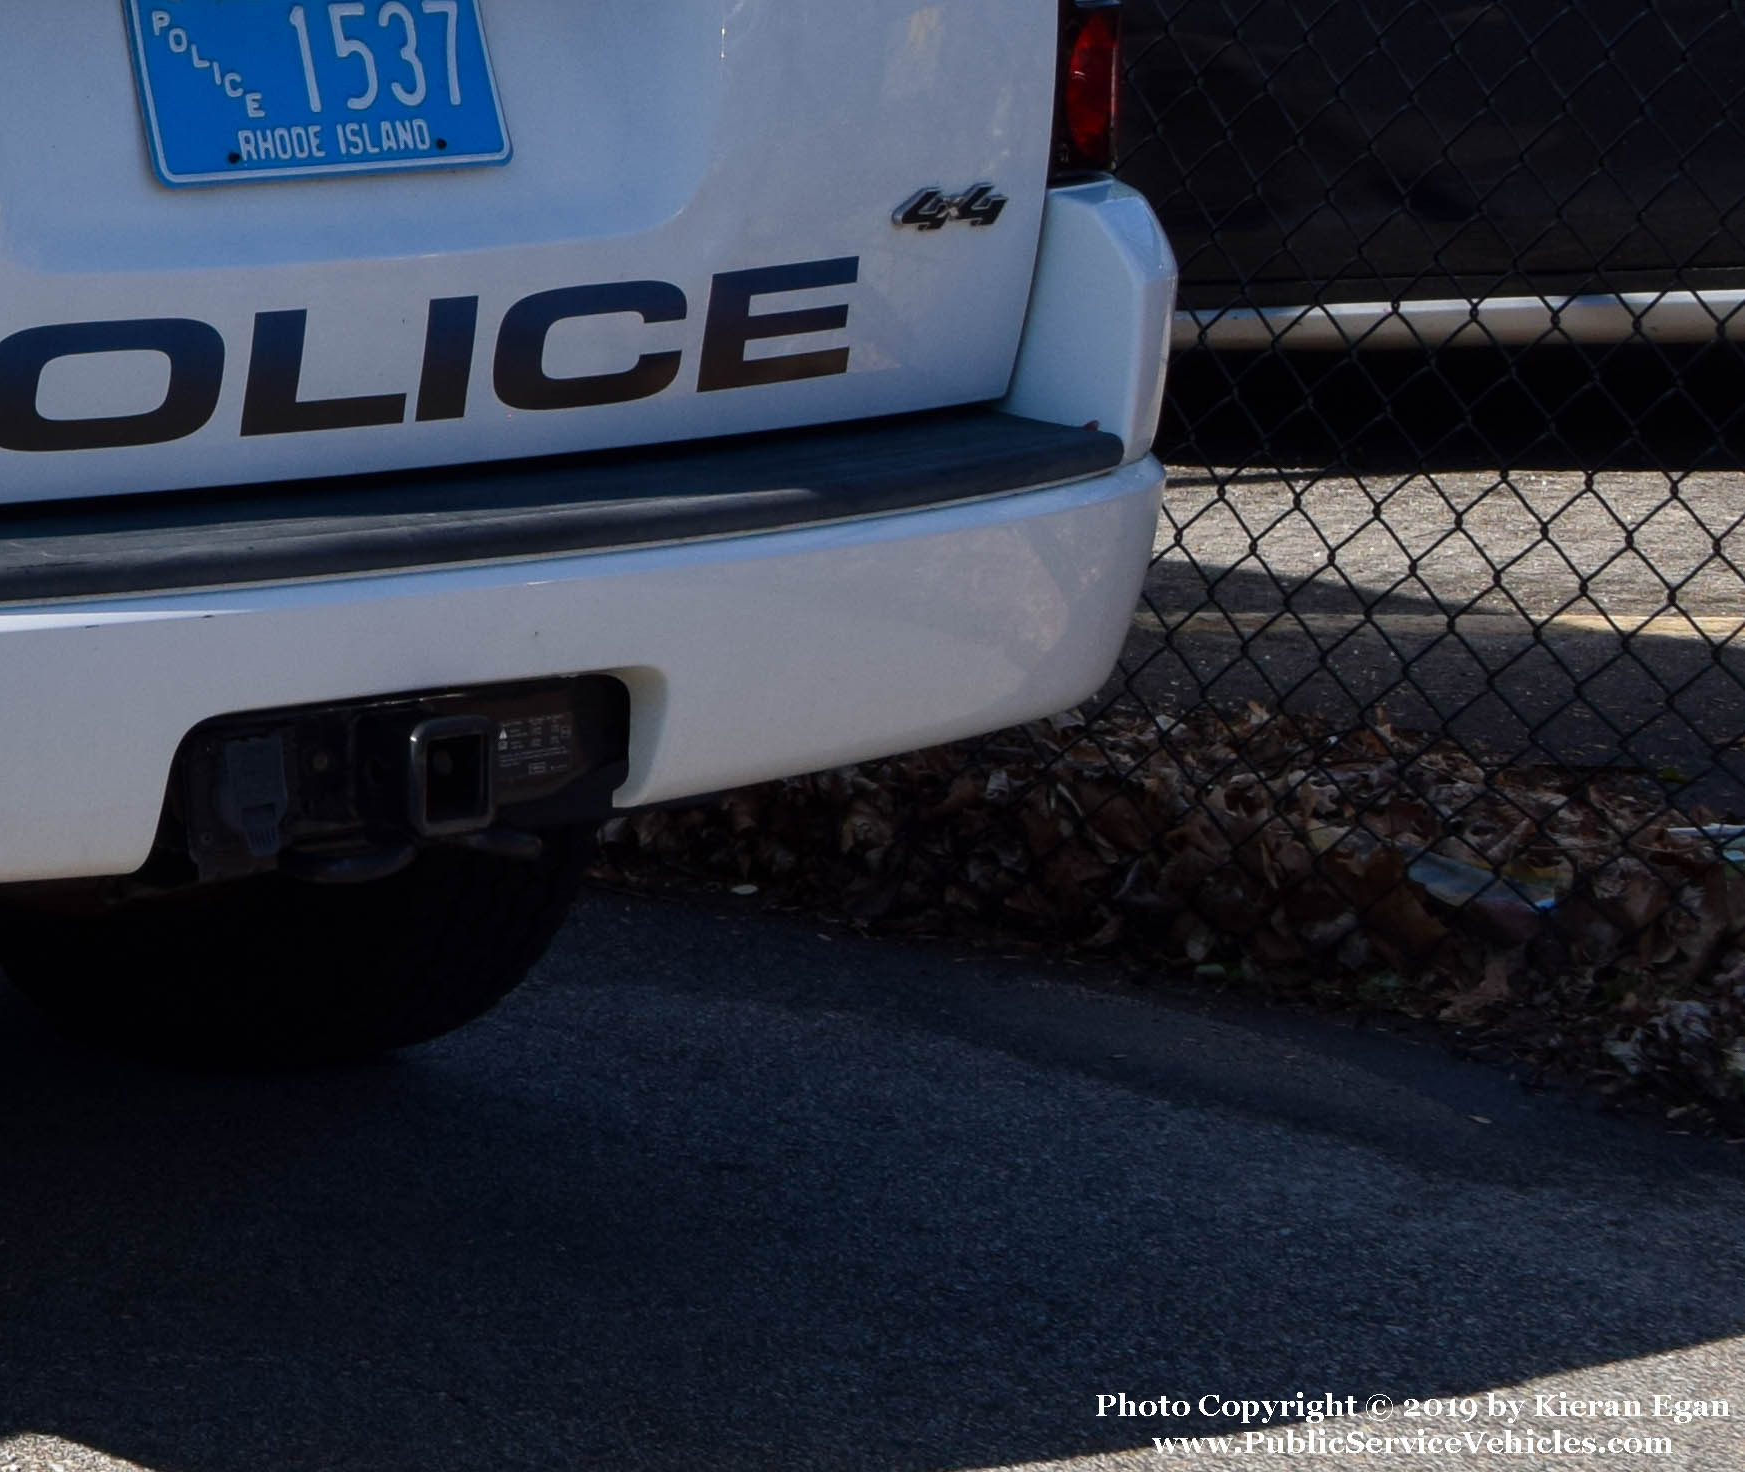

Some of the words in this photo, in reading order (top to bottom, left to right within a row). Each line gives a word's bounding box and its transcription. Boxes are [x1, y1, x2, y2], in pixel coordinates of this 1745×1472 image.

[151, 10, 266, 118] POLICE
[289, 0, 461, 113] 1537
[237, 125, 326, 161] RHODE
[336, 118, 431, 154] ISLAND
